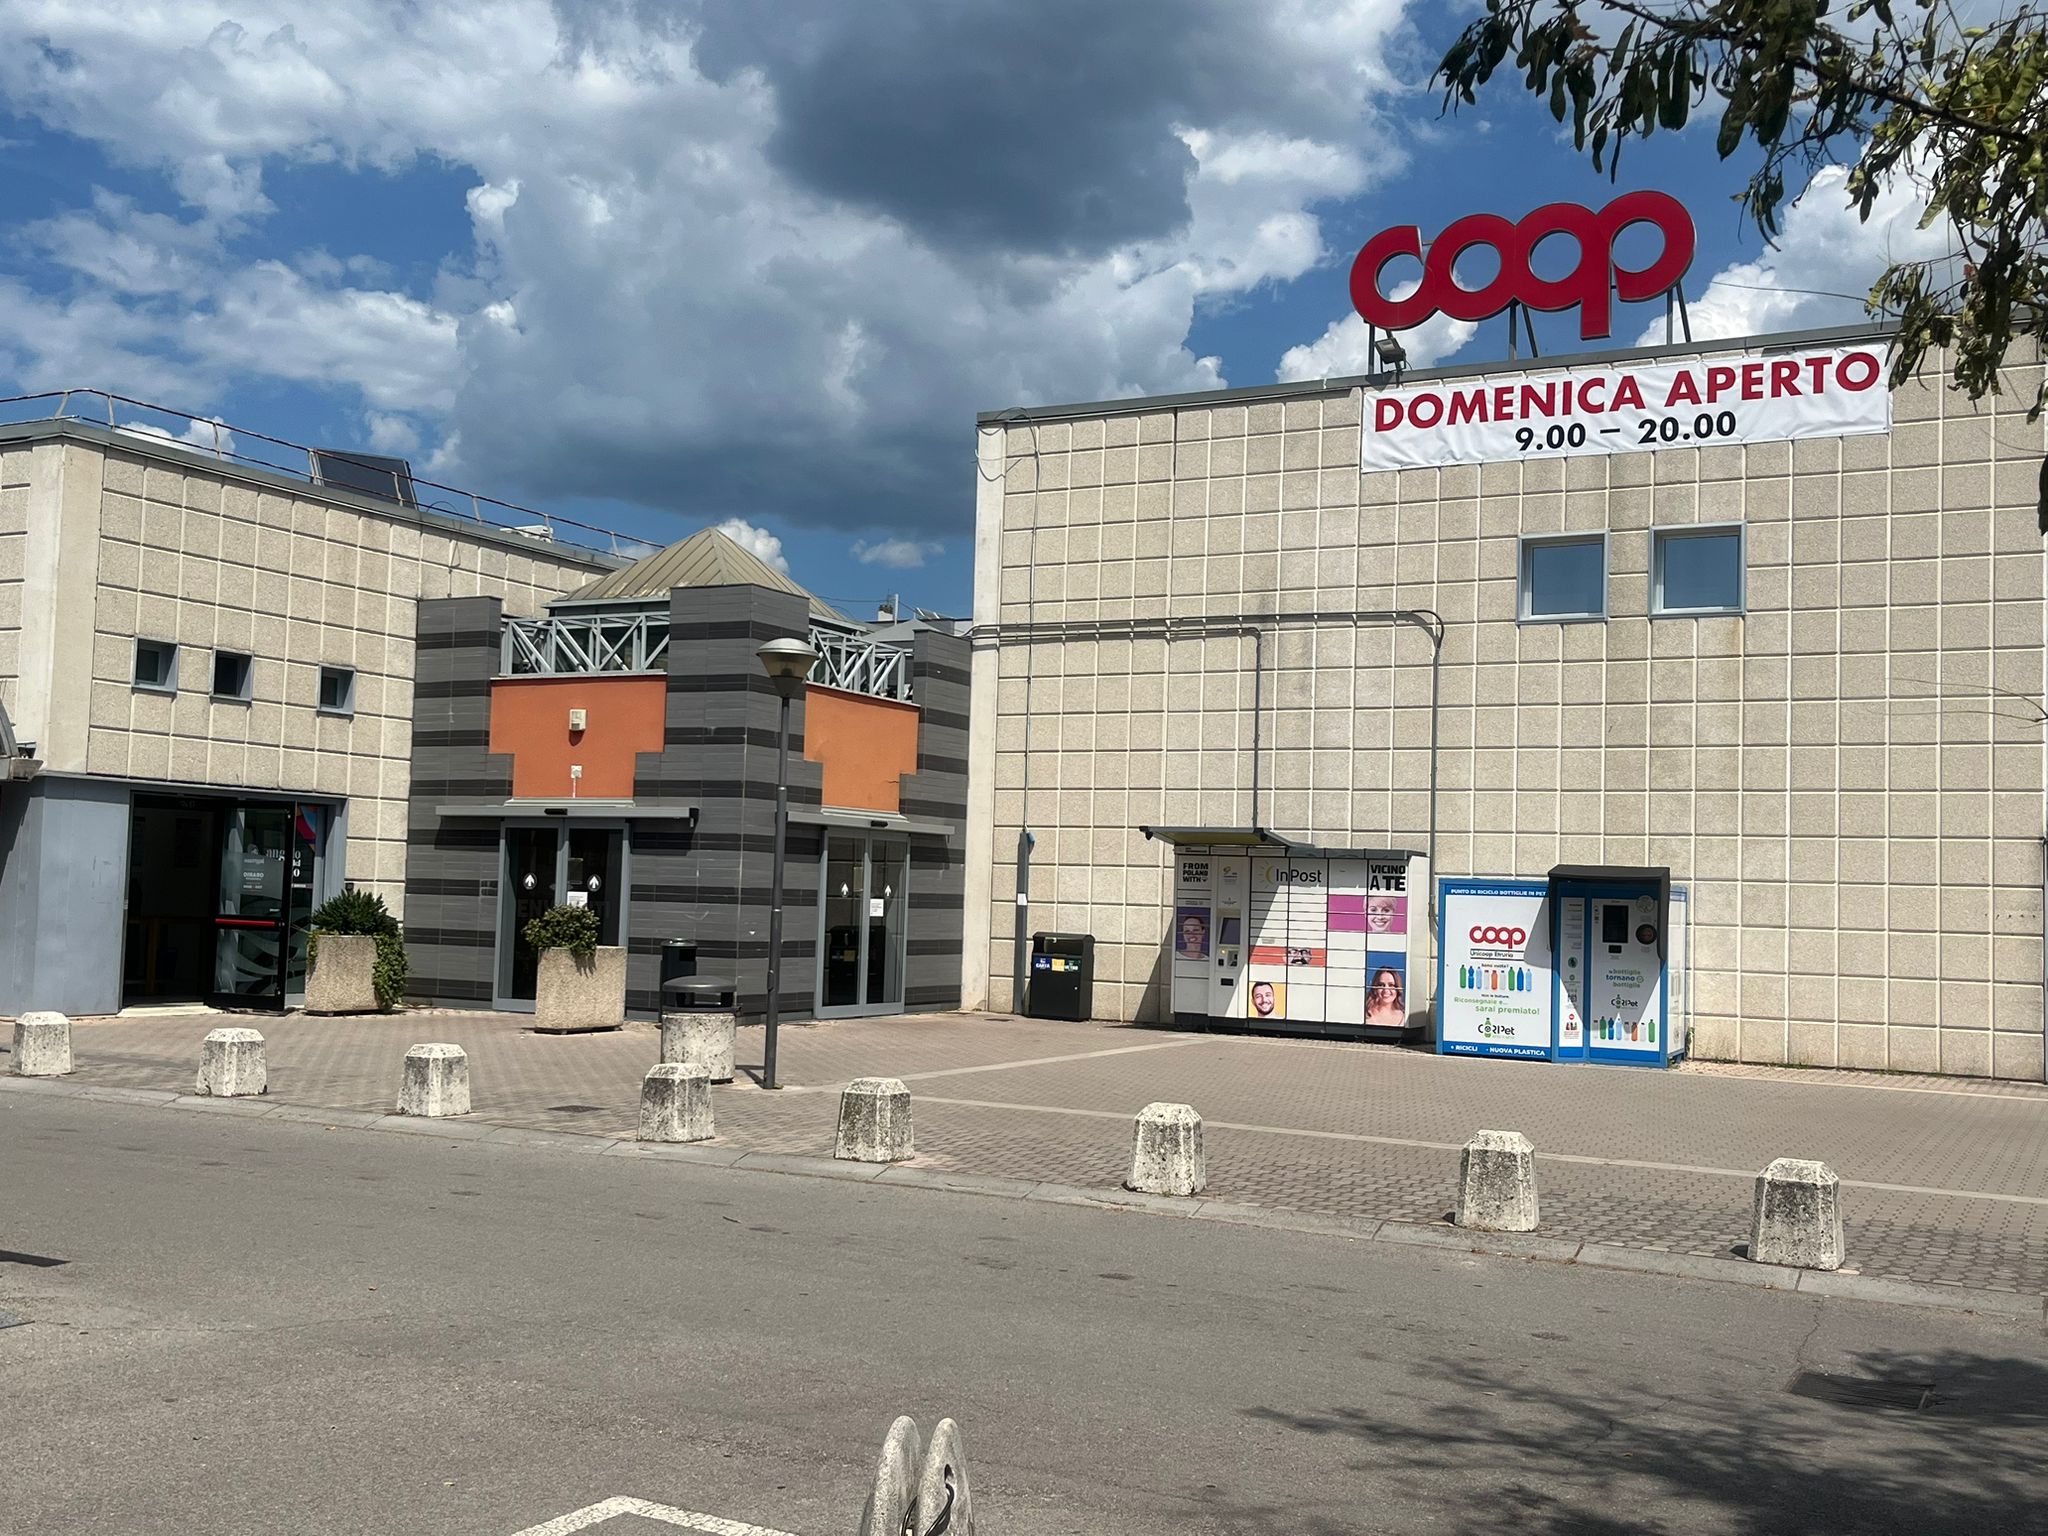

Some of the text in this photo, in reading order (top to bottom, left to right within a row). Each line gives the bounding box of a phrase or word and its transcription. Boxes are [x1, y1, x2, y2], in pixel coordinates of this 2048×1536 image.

[1349, 189, 1697, 341] coop
[1374, 352, 1881, 432] DOMENICA APERTO
[1515, 422, 1587, 452] 9.00
[1638, 411, 1736, 445] 20.00
[1182, 862, 1209, 870] FROM
[1370, 864, 1406, 875] VICINO
[1275, 868, 1323, 884] InPost
[1369, 875, 1407, 892] A TE
[1469, 925, 1526, 949] coop
[1470, 949, 1514, 958] Unicoop Etruria
[1475, 1005, 1540, 1015] sarai premiato!
[1514, 1048, 1545, 1056] PLASTICA
